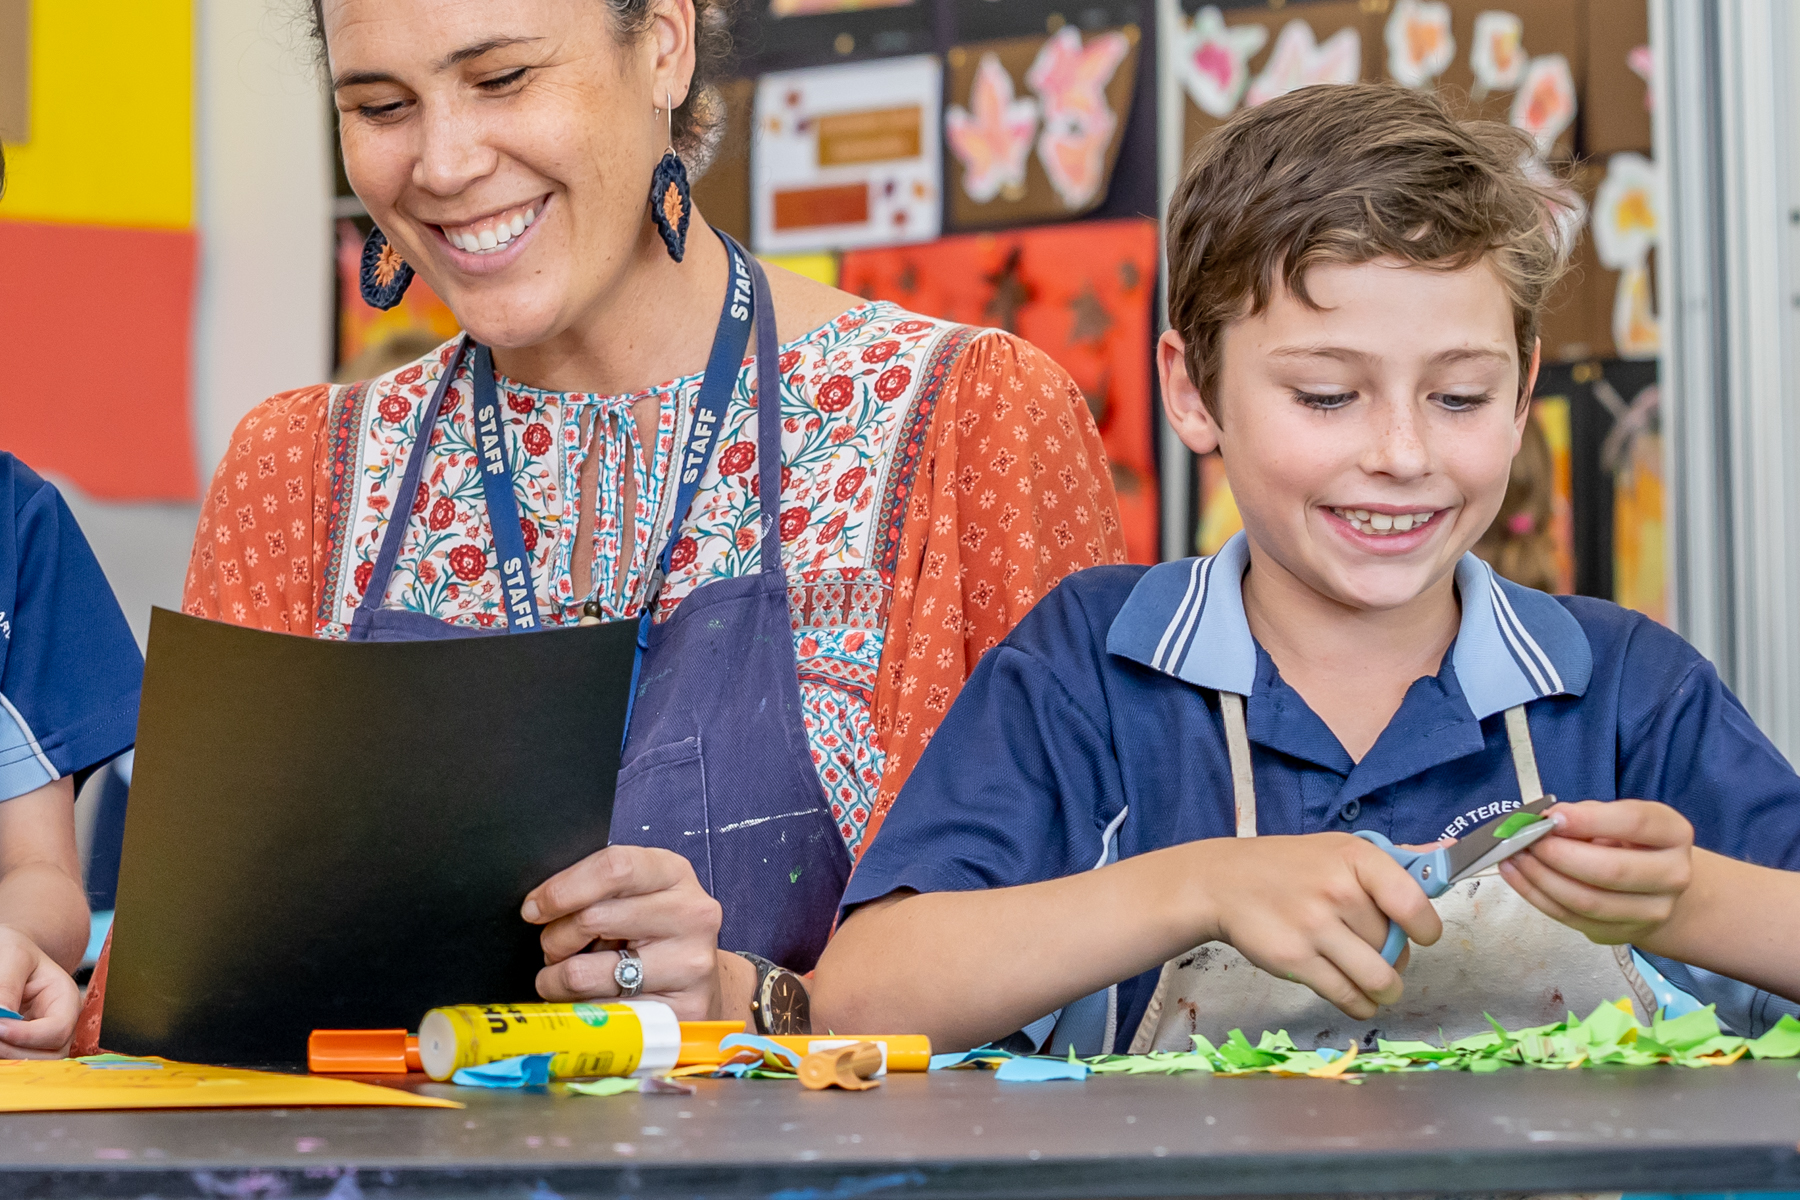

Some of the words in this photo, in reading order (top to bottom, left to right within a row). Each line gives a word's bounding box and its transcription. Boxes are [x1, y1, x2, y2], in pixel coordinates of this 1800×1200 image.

[730, 252, 751, 322] STAFF
[478, 404, 504, 475] STAFF
[683, 408, 717, 484] STAFF
[503, 557, 535, 629] STAFF
[1465, 800, 1522, 823] TERES
